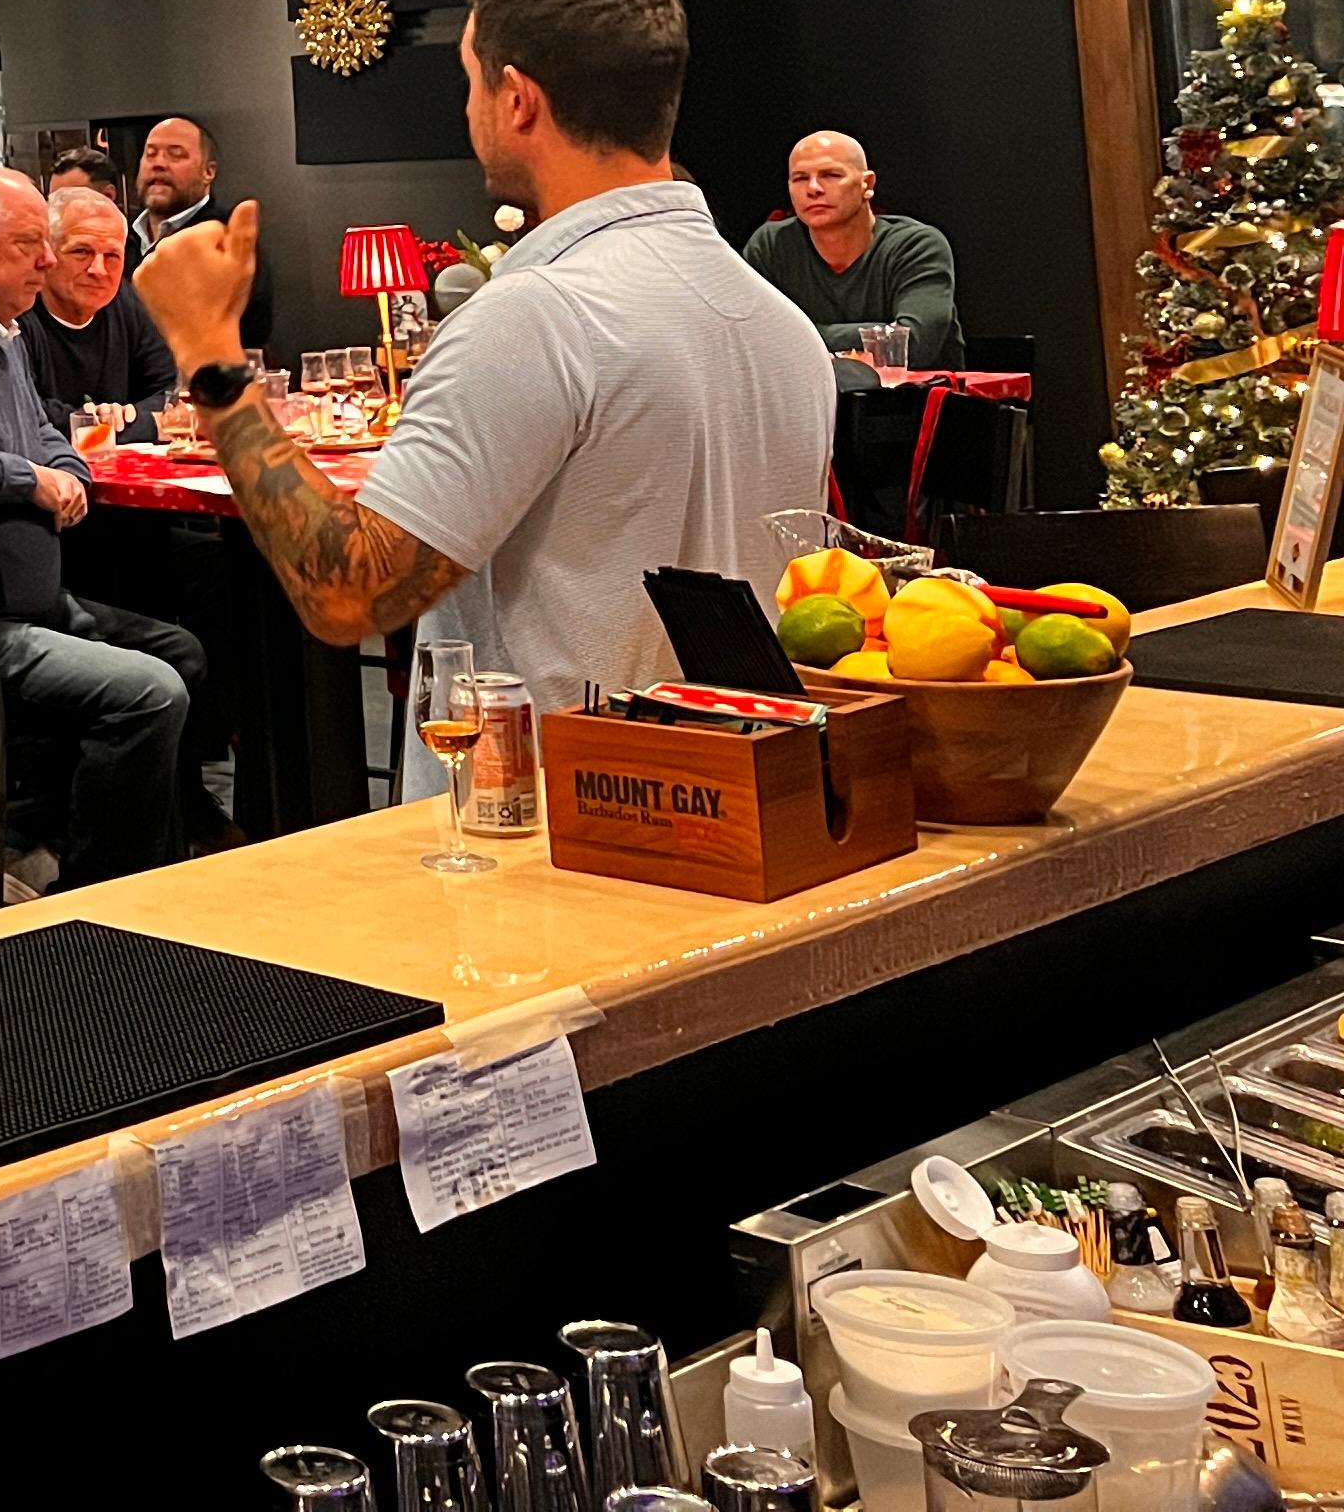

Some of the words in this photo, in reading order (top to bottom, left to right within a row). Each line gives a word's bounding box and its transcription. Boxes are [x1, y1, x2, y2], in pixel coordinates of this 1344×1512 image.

[575, 769, 664, 811] MOUNT
[671, 783, 722, 820] GAY
[577, 800, 638, 822] Barbados
[640, 809, 673, 829] Rum
